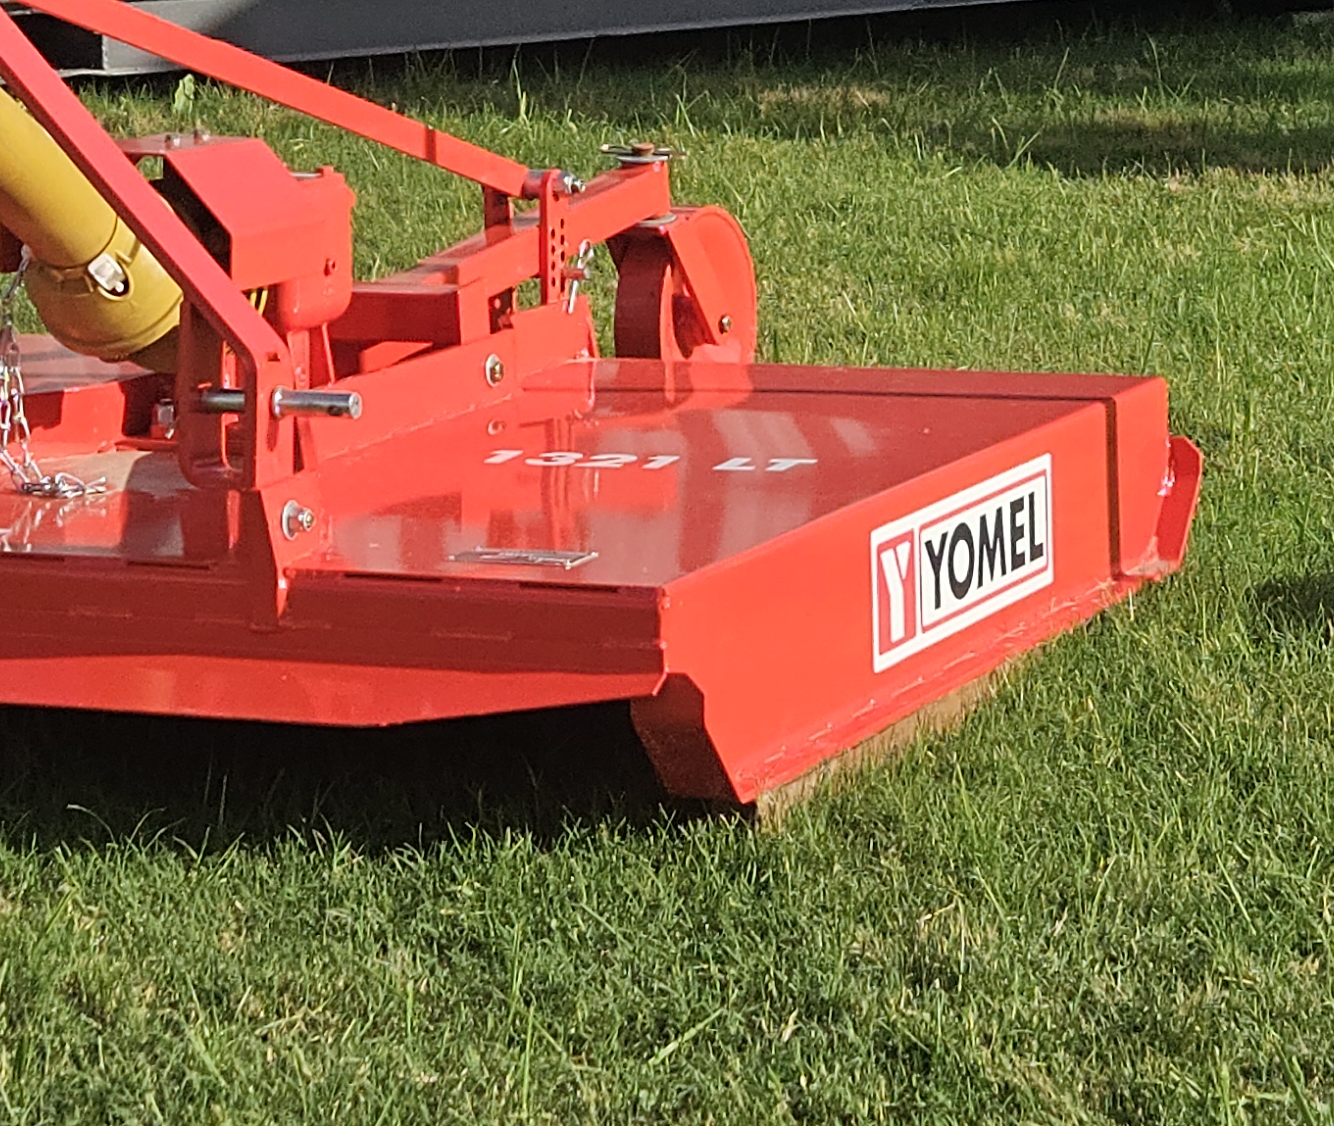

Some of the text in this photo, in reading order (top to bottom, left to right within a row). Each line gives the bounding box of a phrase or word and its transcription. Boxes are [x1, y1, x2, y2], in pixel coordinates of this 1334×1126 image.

[483, 449, 819, 472] 1321 LT
[923, 490, 1045, 611] YOMEL
